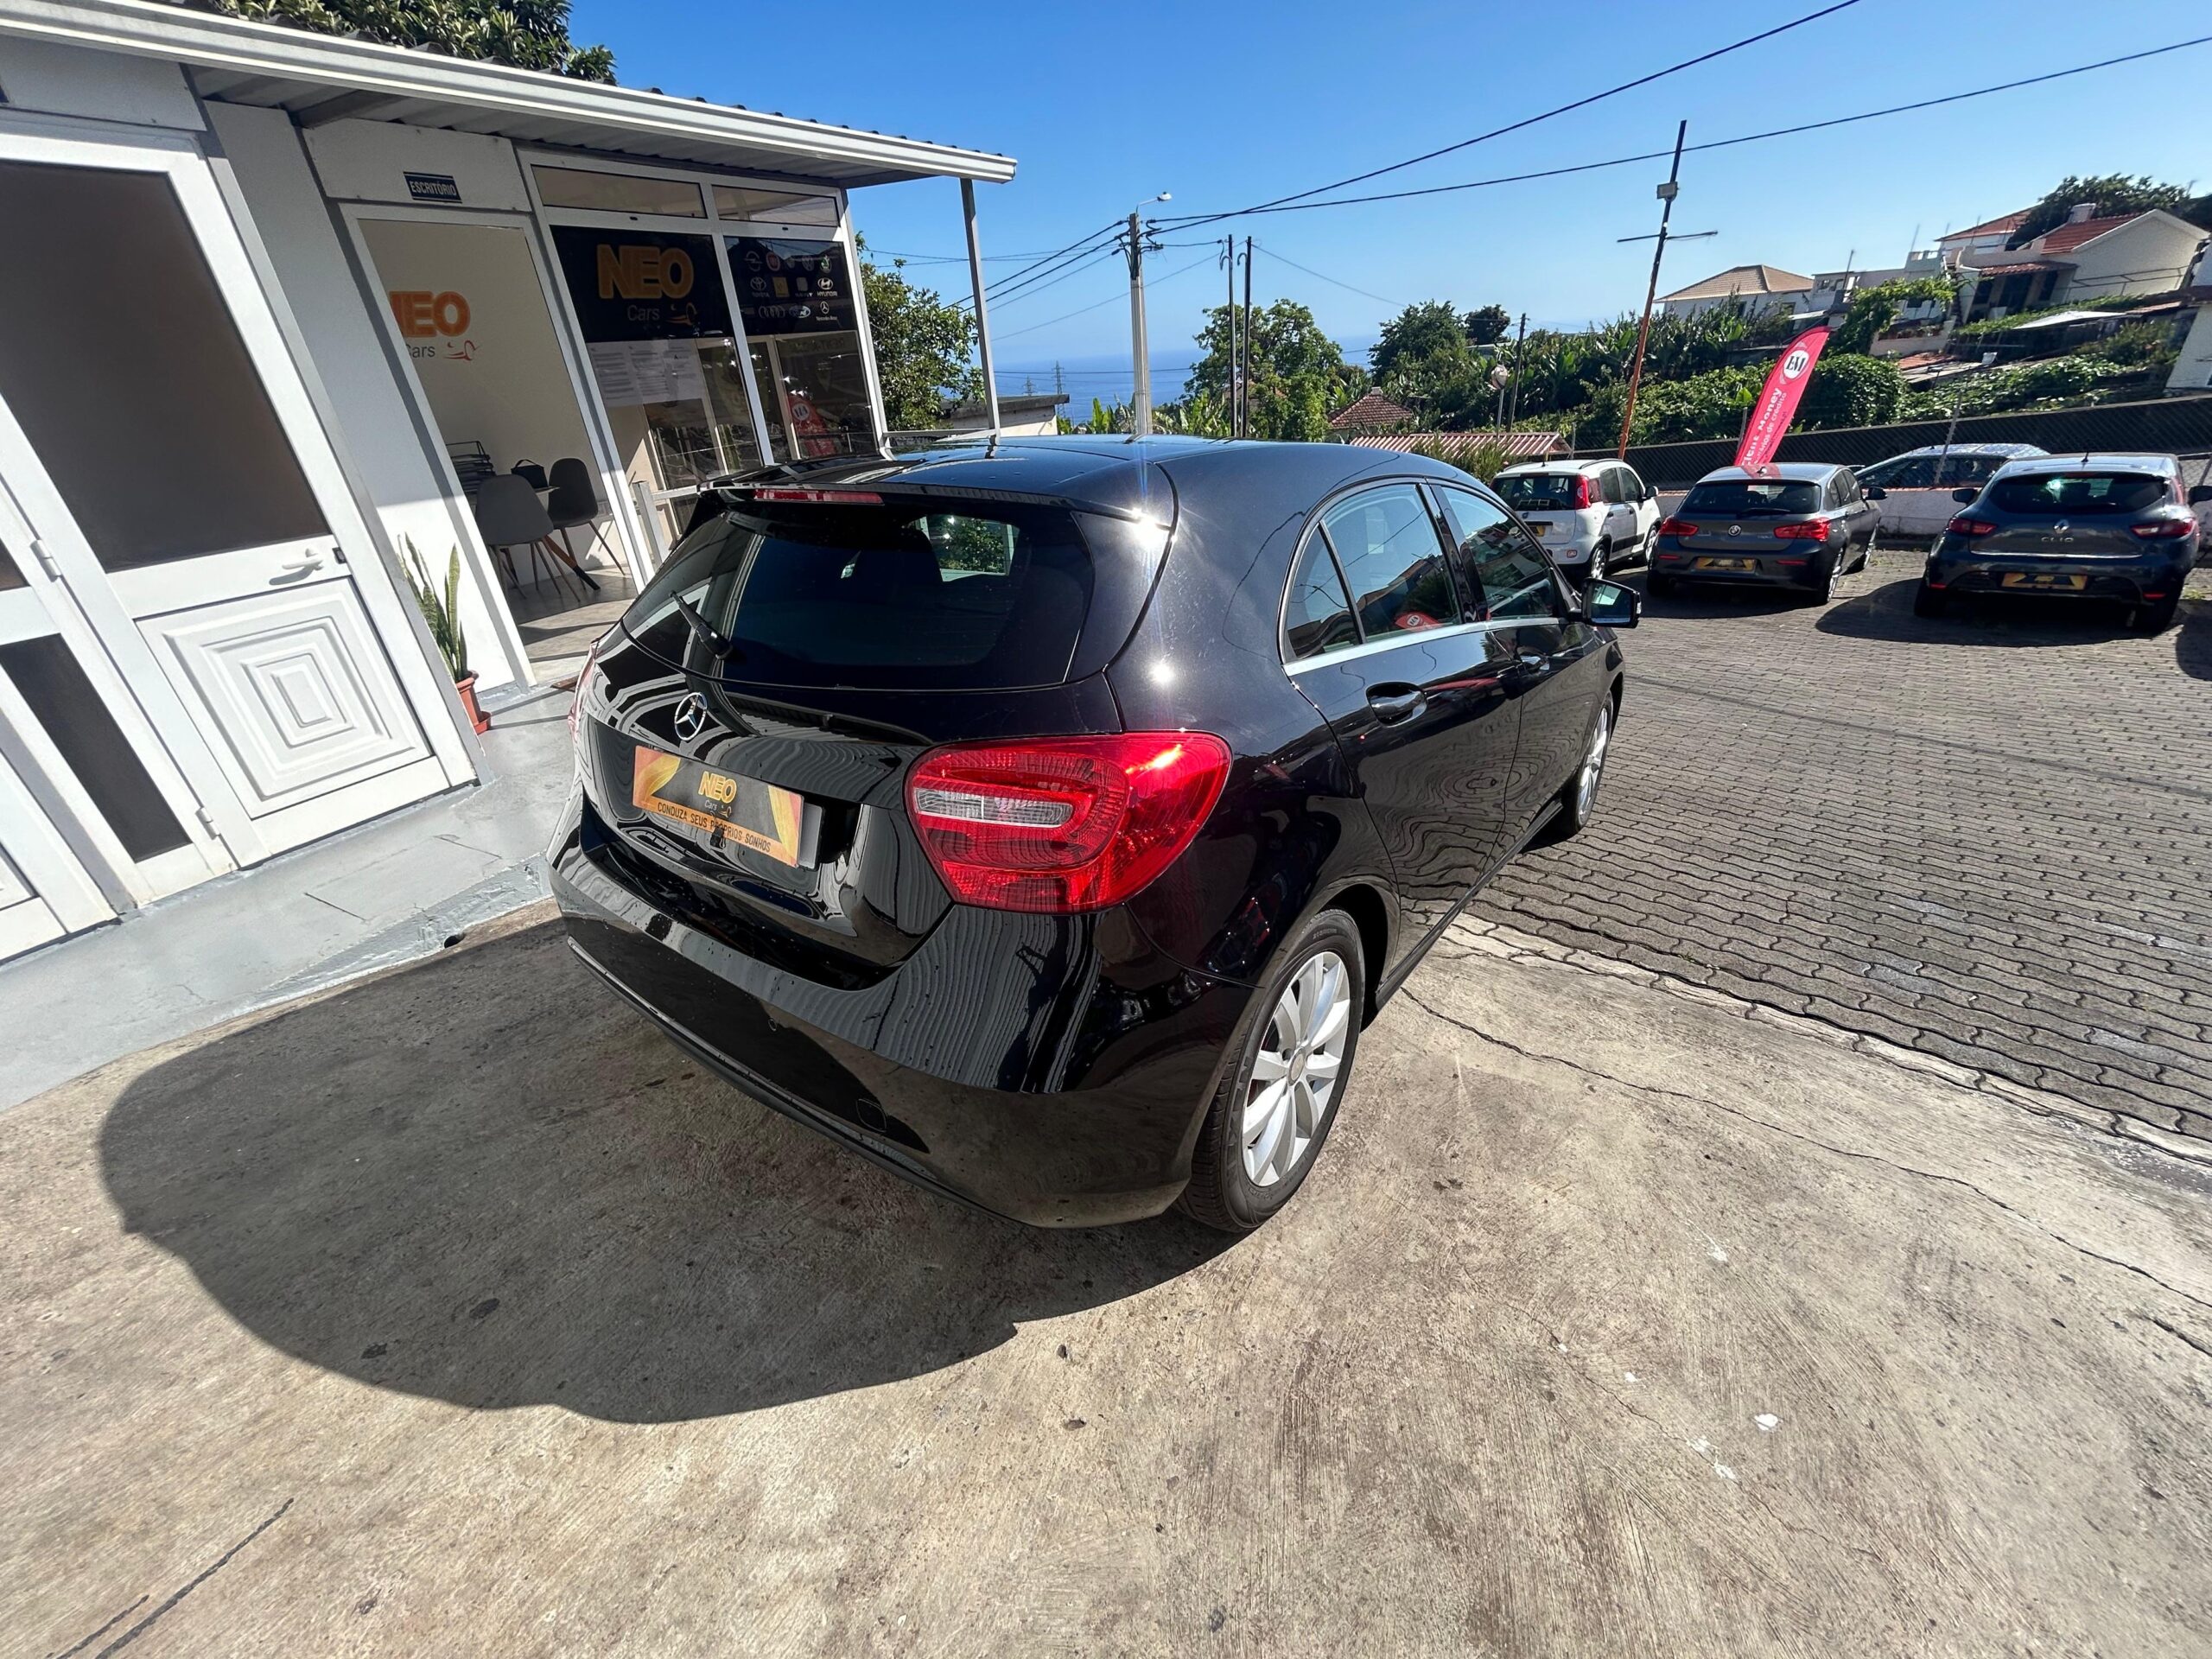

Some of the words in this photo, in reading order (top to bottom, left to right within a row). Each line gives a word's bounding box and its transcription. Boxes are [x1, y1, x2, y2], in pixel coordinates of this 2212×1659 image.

[409, 181, 457, 196] ESCRITÓRIO
[596, 244, 694, 299] NEO
[626, 304, 660, 321] Cars
[1758, 387, 1783, 431] Money
[697, 771, 738, 804] NEO
[704, 799, 718, 811] Cars
[658, 802, 689, 823] CONDUZA
[690, 813, 708, 829] SEUS
[744, 833, 772, 853] SONHOS
